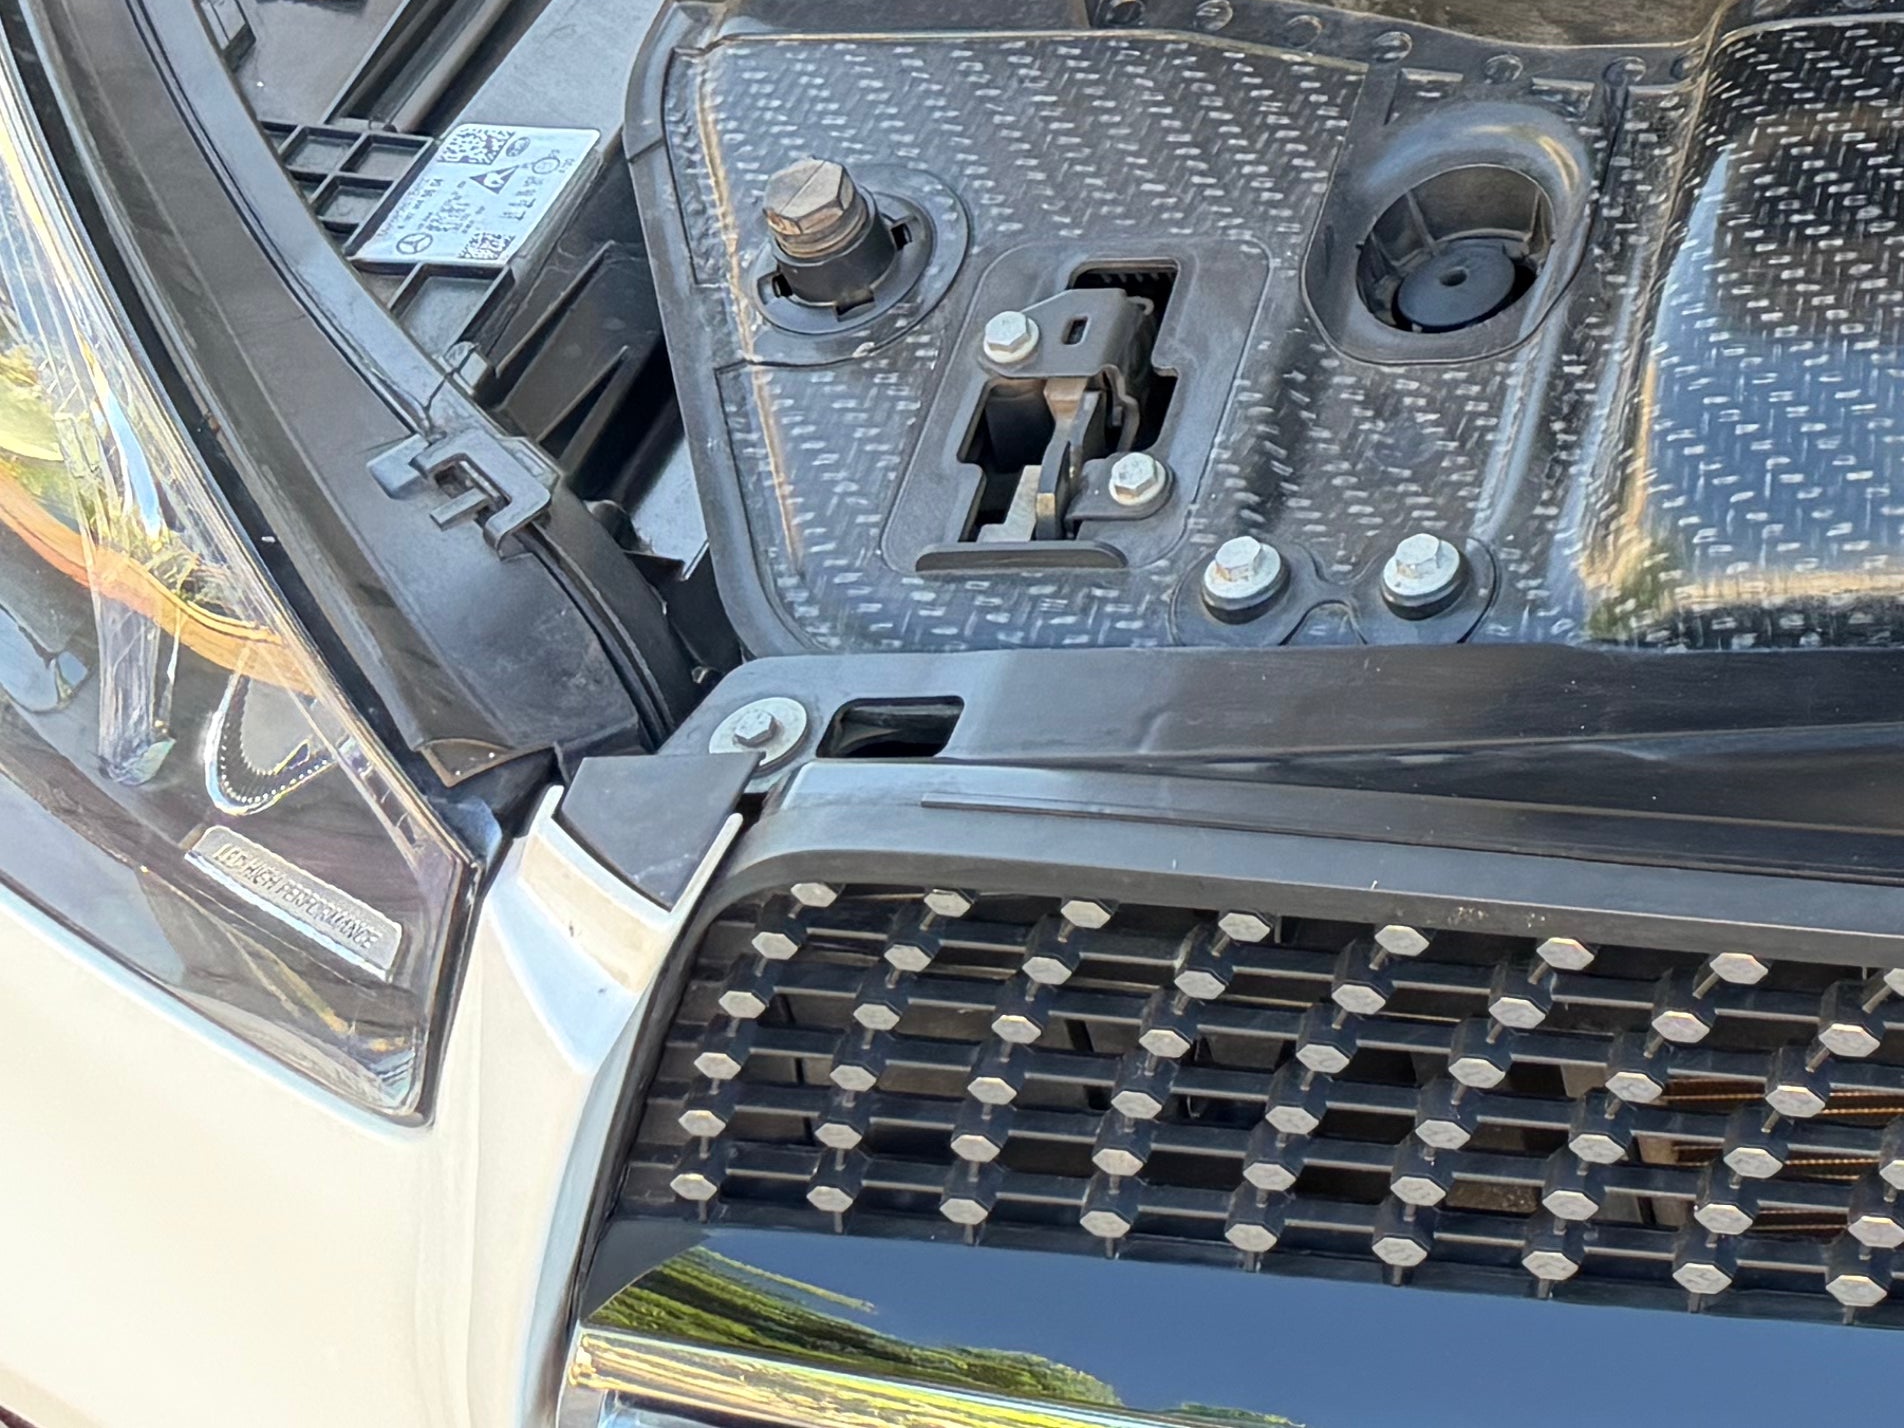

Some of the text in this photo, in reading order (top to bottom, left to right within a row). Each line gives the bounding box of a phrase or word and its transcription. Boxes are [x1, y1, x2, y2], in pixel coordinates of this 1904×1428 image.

[213, 843, 383, 949] LED HIGH PERFORMANCE
